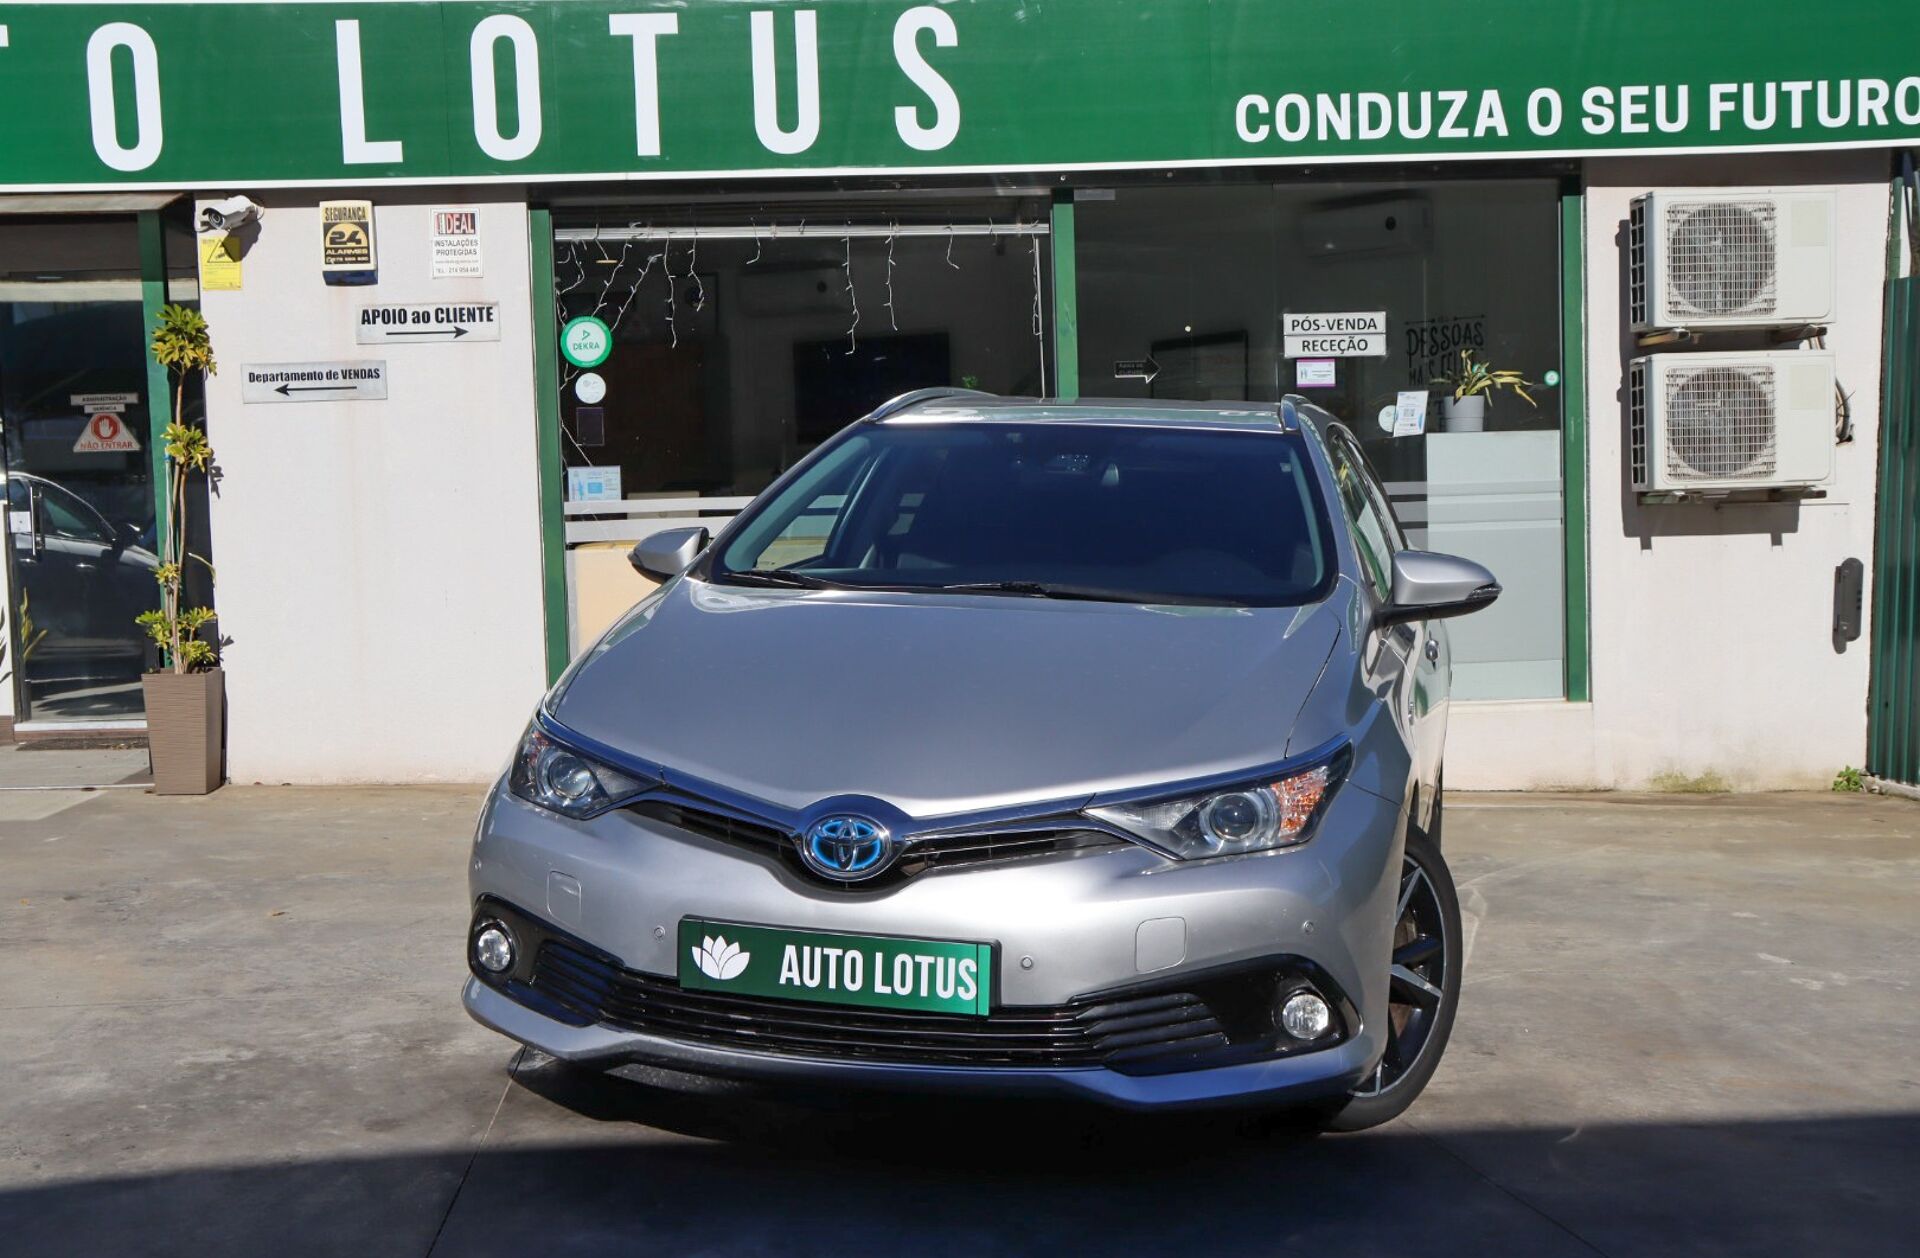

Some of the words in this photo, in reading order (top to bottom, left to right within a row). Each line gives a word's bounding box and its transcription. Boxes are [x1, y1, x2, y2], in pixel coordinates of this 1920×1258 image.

[335, 7, 961, 164] LOTUS
[1235, 89, 1509, 143] CONDUZA
[1527, 87, 1563, 136] O
[1581, 84, 1689, 135] SEU
[1709, 76, 1920, 131] FUTURO
[325, 206, 367, 222] SEGURANÇA
[435, 212, 476, 235] IDEAL
[329, 230, 362, 246] 24
[434, 239, 479, 247] INSTALAÇÕES
[436, 248, 477, 256] PROTEGIDAS
[361, 308, 407, 325] APOIO
[411, 311, 431, 324] ao
[434, 306, 494, 323] CLIENTE
[1291, 315, 1378, 331] PÓS-VENDA
[573, 342, 600, 350] DEKRA
[1302, 336, 1368, 354] RECEÇÃO
[1406, 321, 1485, 367] PESSOAS
[248, 370, 324, 383] Departamento
[326, 370, 339, 381] de
[341, 368, 380, 380] VENDAS
[81, 441, 99, 449] NÃO
[101, 441, 133, 449] ENTRAR
[779, 944, 863, 991] AUTO
[874, 952, 977, 1001] LOTUS
